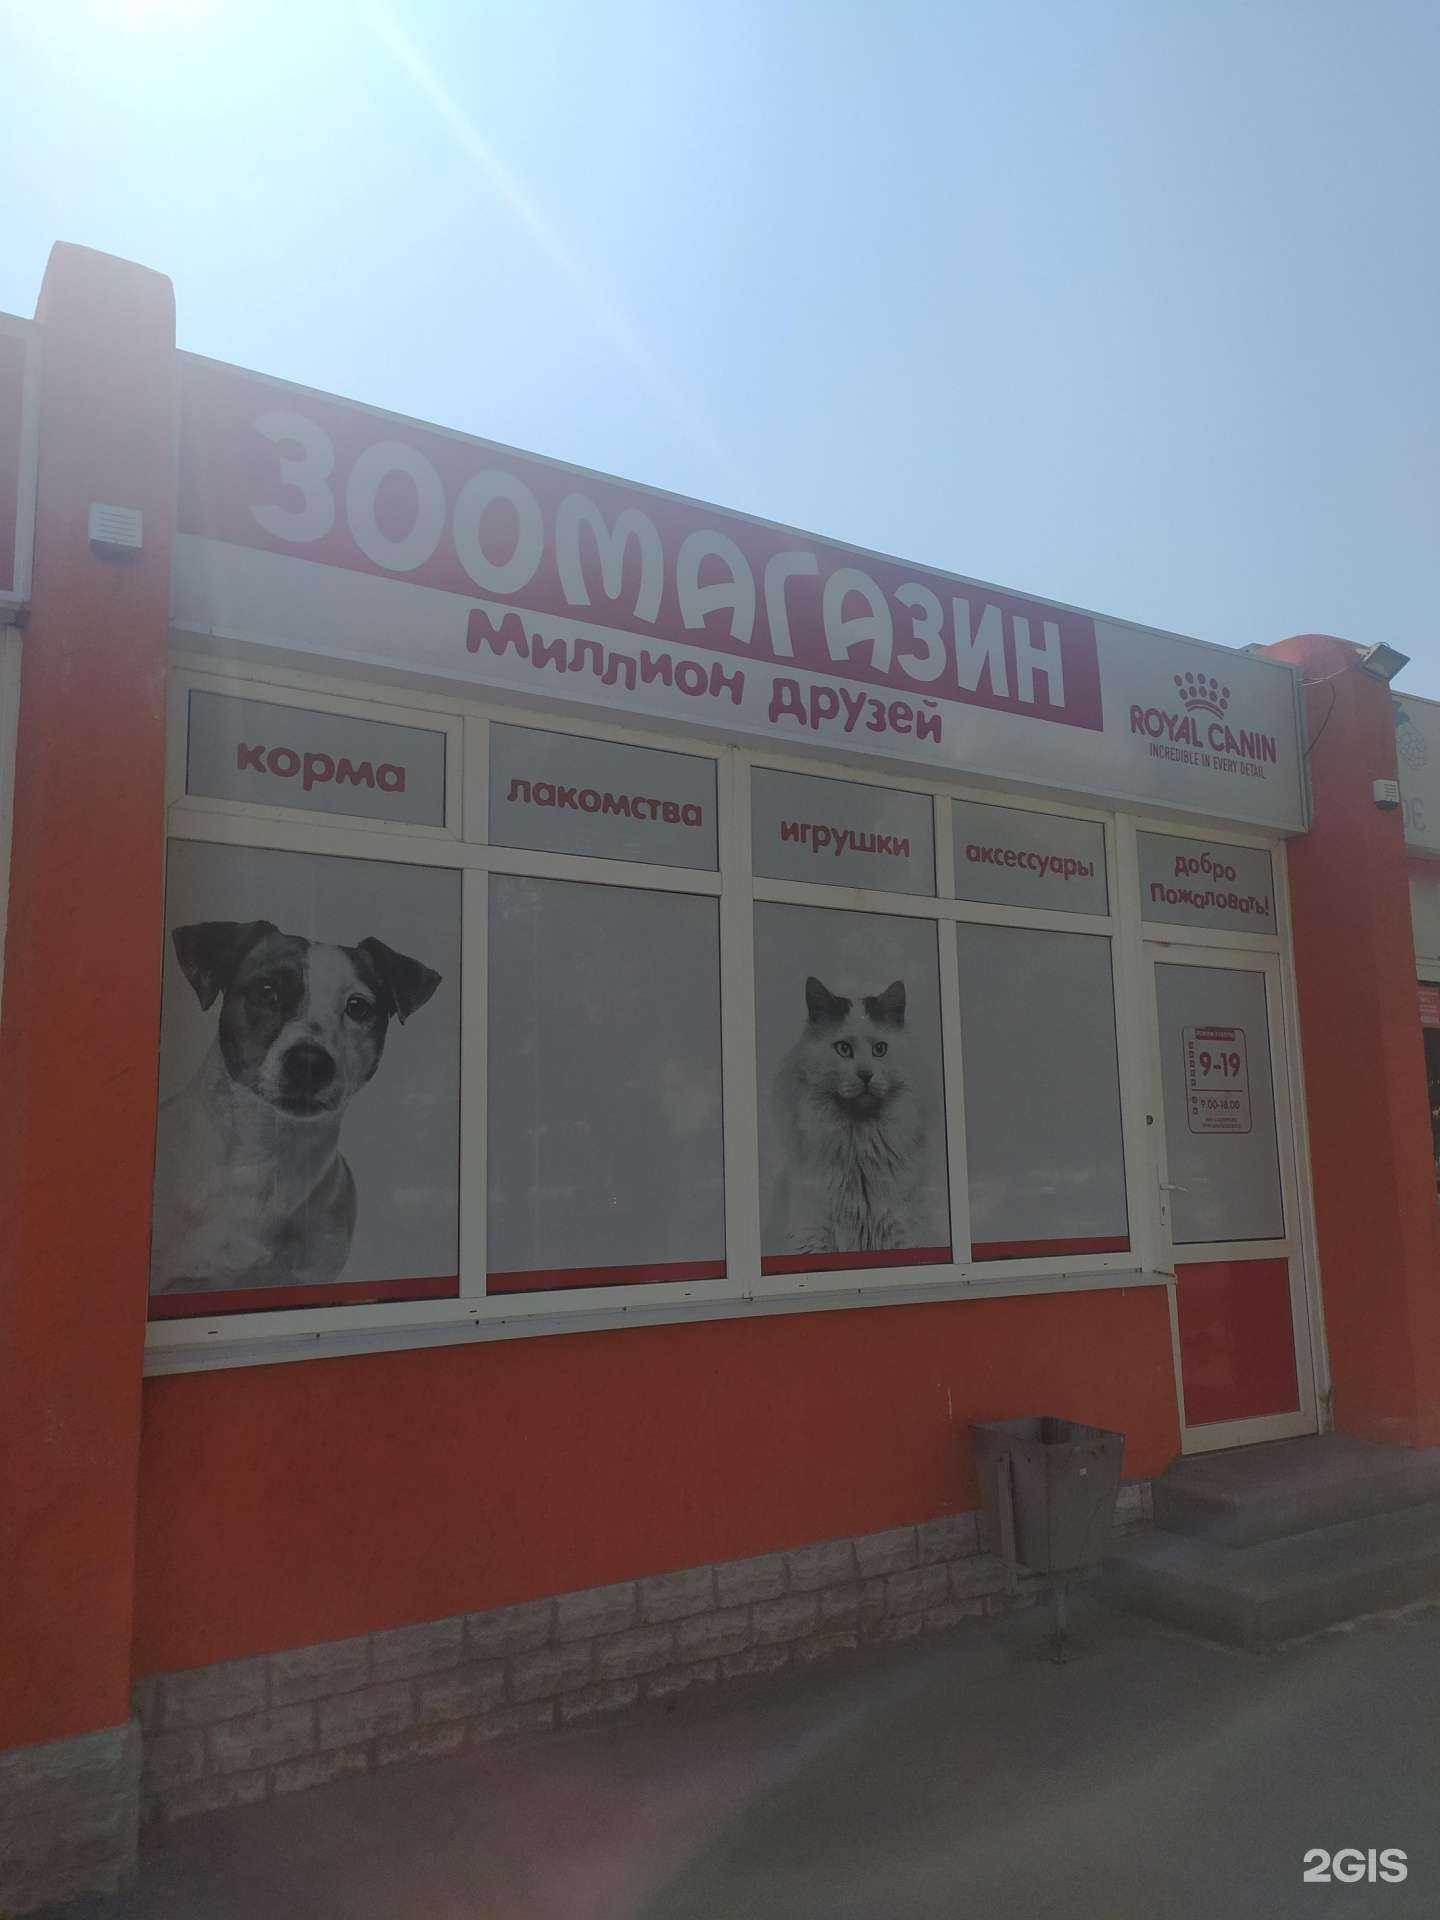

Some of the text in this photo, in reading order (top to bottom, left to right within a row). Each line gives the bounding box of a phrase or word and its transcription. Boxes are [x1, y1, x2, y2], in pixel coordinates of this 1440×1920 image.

[249, 411, 1066, 709] ЗООМАГАЗИН
[466, 609, 745, 705] Миллион
[1130, 704, 1277, 764] ROYAL CANIN
[236, 742, 406, 792] корма
[1150, 743, 1267, 780] INCREDIBLE IN EVERY DETAIL
[507, 778, 703, 828] лакомства
[780, 820, 910, 858] игрушки
[965, 843, 1095, 881] аксессуары
[1199, 1051, 1241, 1078] 9-19
